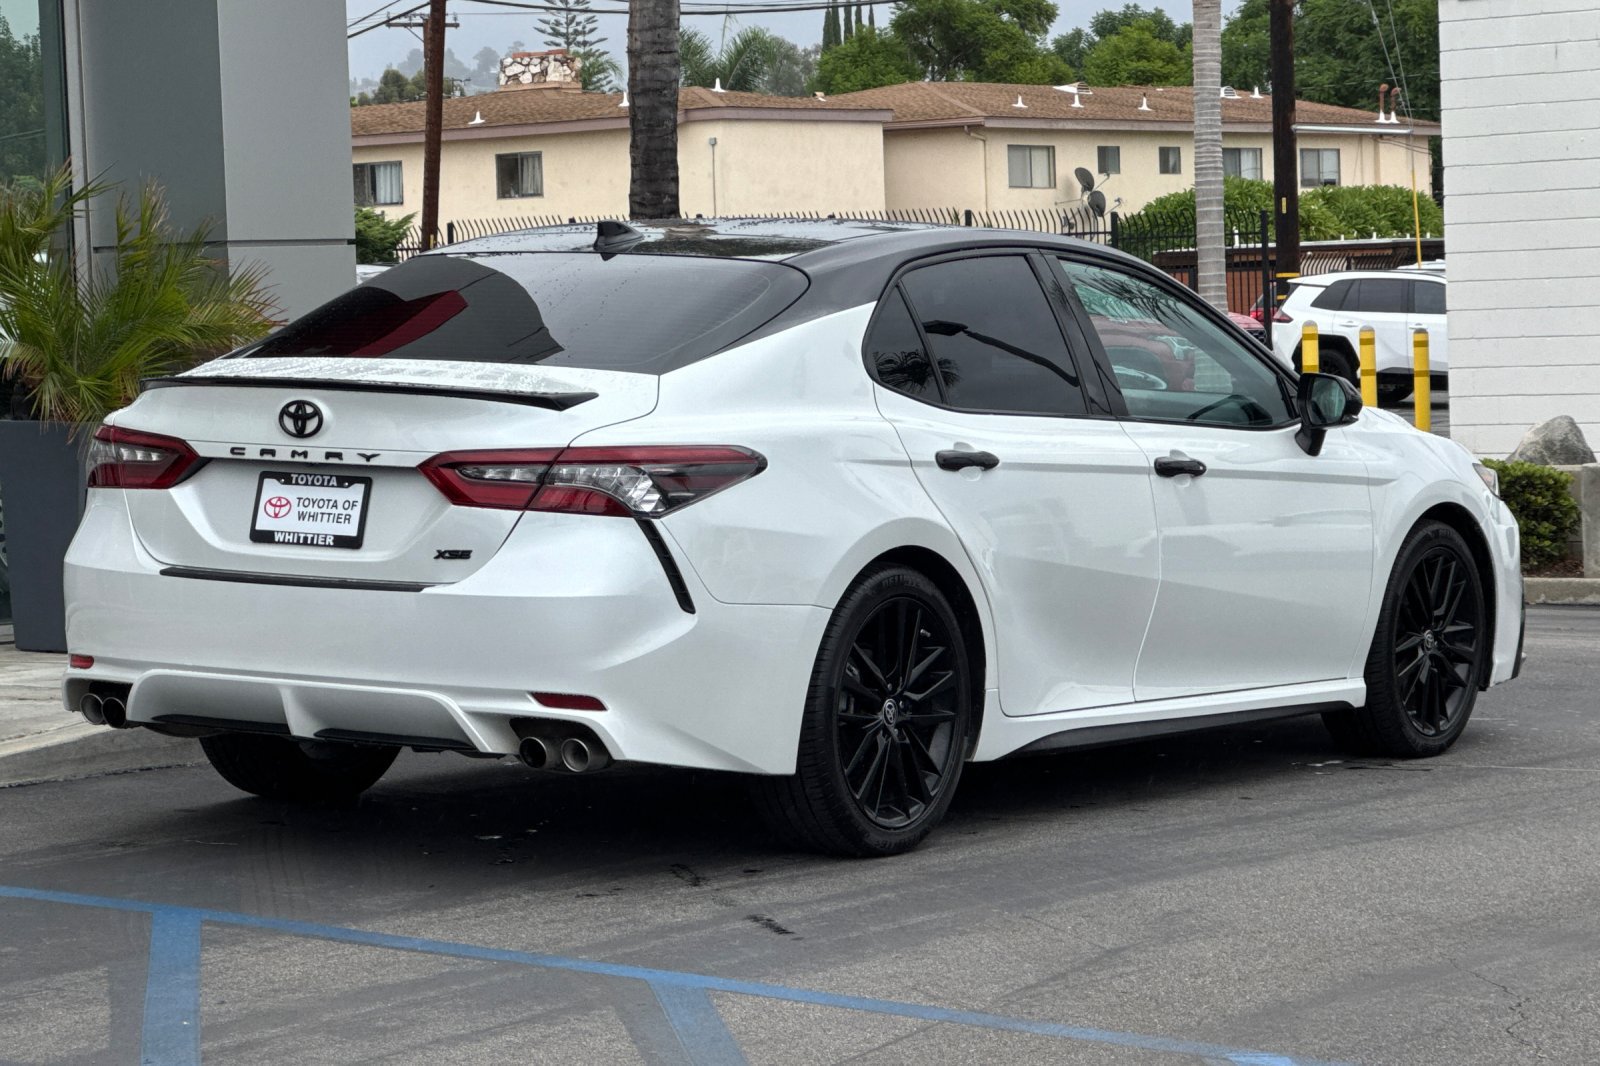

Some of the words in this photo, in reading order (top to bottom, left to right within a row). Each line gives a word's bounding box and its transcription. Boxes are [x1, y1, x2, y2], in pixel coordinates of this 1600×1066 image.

[230, 447, 381, 462] CAMRY
[291, 474, 337, 487] TOYOTA
[296, 497, 338, 510] TOYOTA
[342, 500, 358, 511] OF
[297, 511, 352, 524] WHITTIER
[274, 531, 334, 546] WHITTIER
[433, 549, 473, 560] XSE
